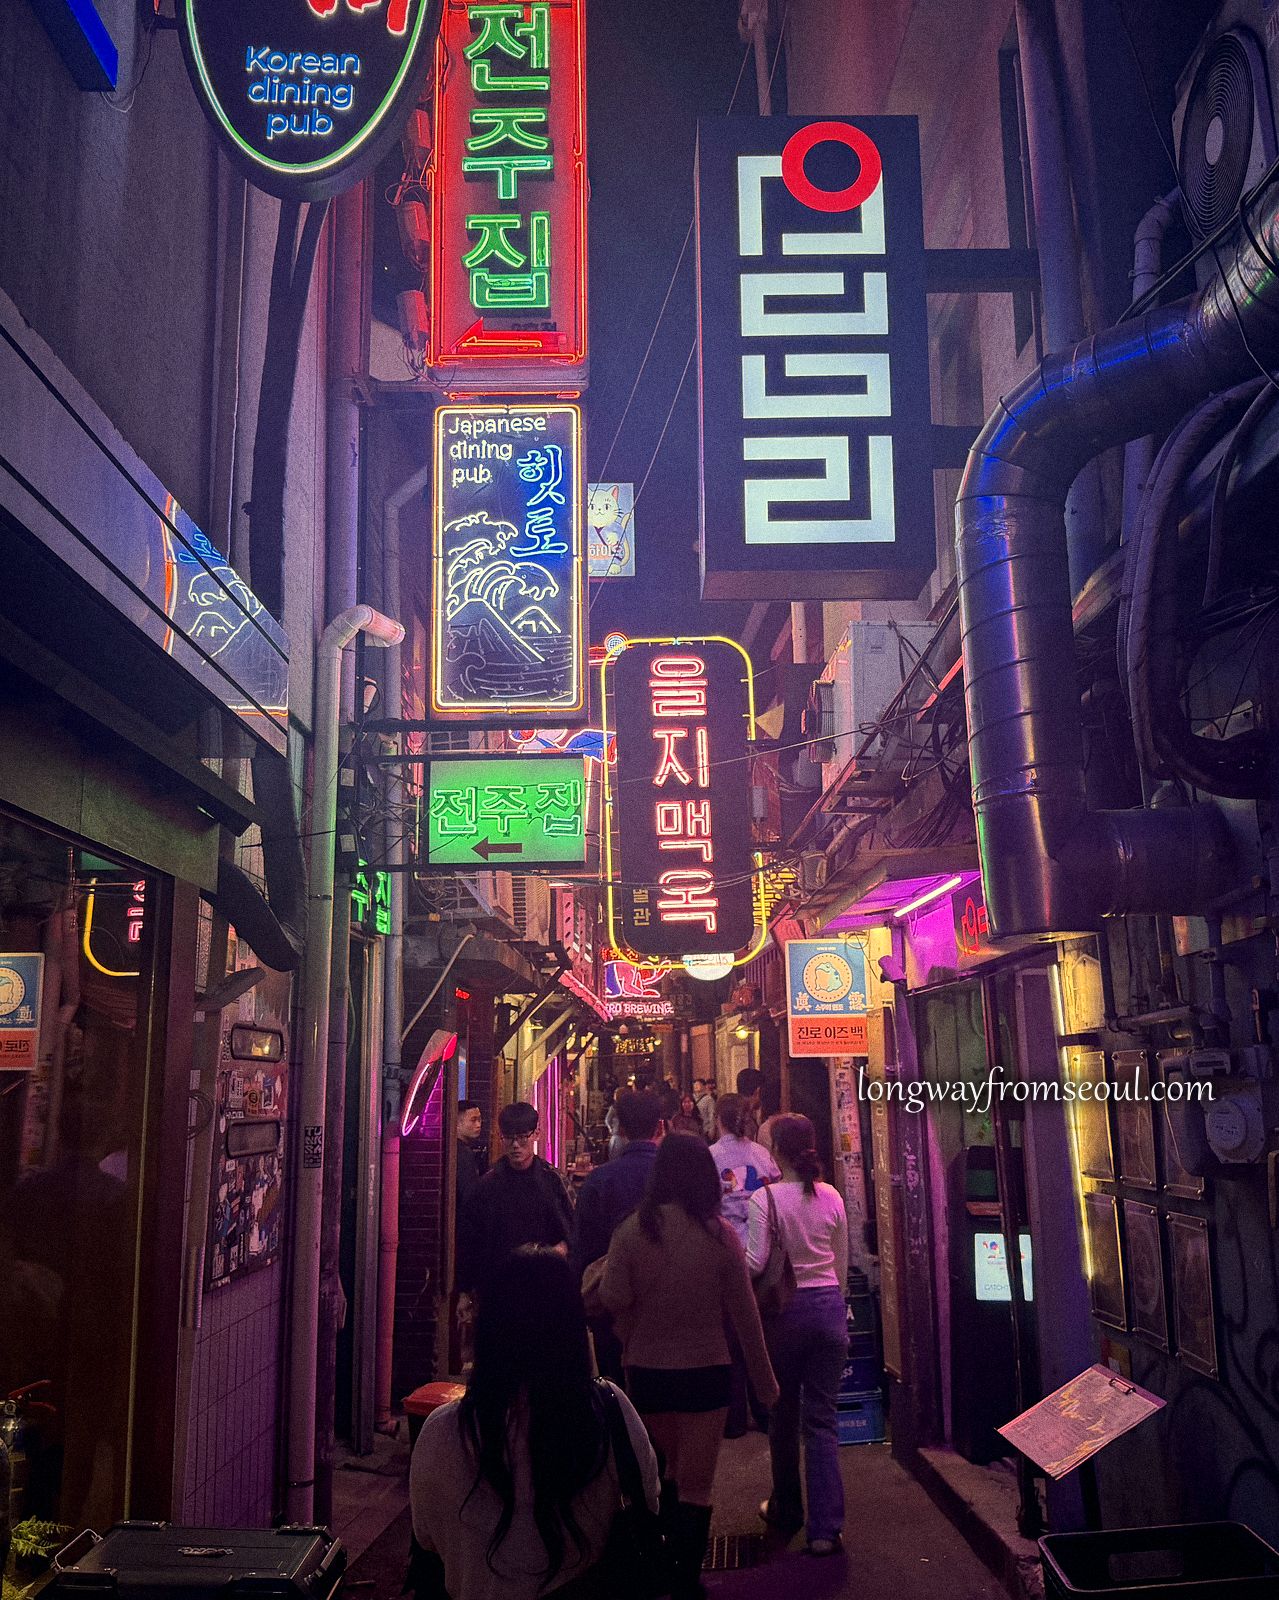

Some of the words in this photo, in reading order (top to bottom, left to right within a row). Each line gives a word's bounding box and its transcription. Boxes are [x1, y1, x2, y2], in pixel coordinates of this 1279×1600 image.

[246, 45, 361, 75] Korean
[247, 76, 355, 109] dining
[266, 109, 333, 139] pub
[462, 3, 553, 311] 전주집
[447, 415, 547, 437] Japanese
[449, 439, 513, 462] dining
[451, 464, 492, 488] pub
[430, 779, 581, 838] 전주집
[648, 656, 719, 933] 을지맥옥
[623, 1003, 674, 1015] BREWING
[797, 1026, 822, 1040] 진로
[824, 1026, 849, 1039] 이즈
[850, 1026, 863, 1039] 백
